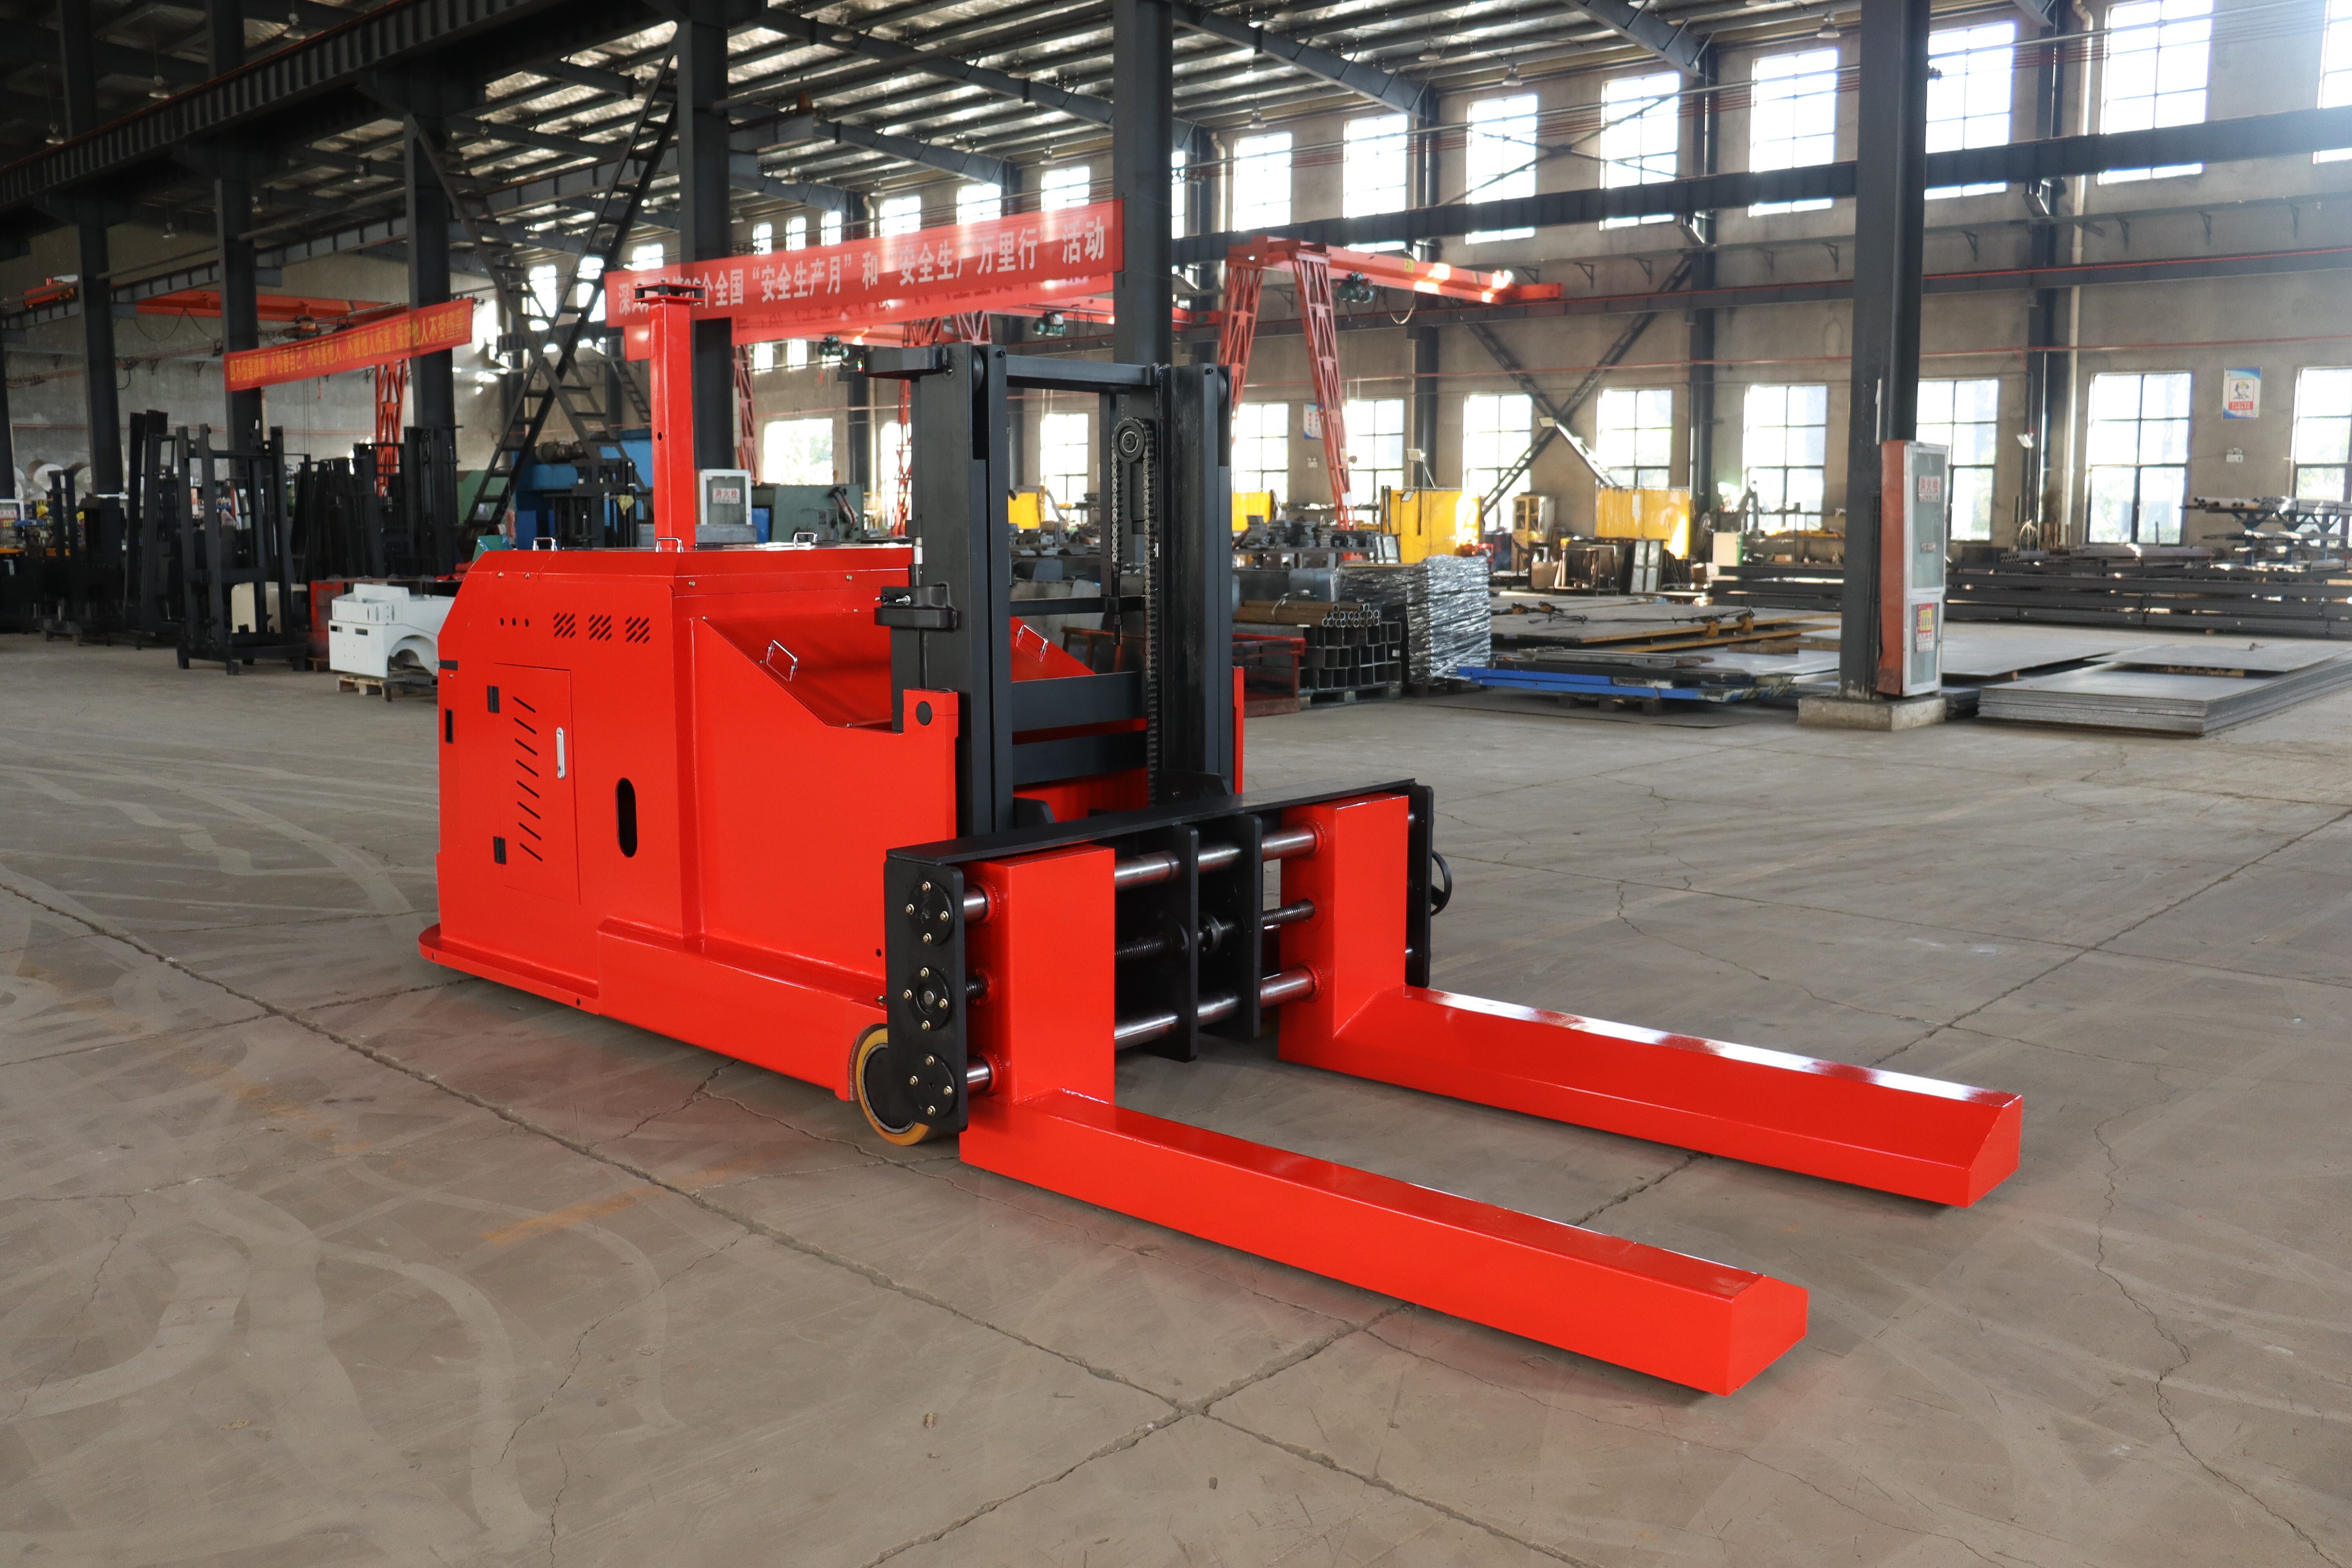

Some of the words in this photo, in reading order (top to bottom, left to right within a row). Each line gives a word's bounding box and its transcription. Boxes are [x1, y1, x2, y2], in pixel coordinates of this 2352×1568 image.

[618, 216, 1105, 316] 深个全国“安全生产月”和“安全生产万里行”活动
[1920, 477, 1938, 492] 消火栓
